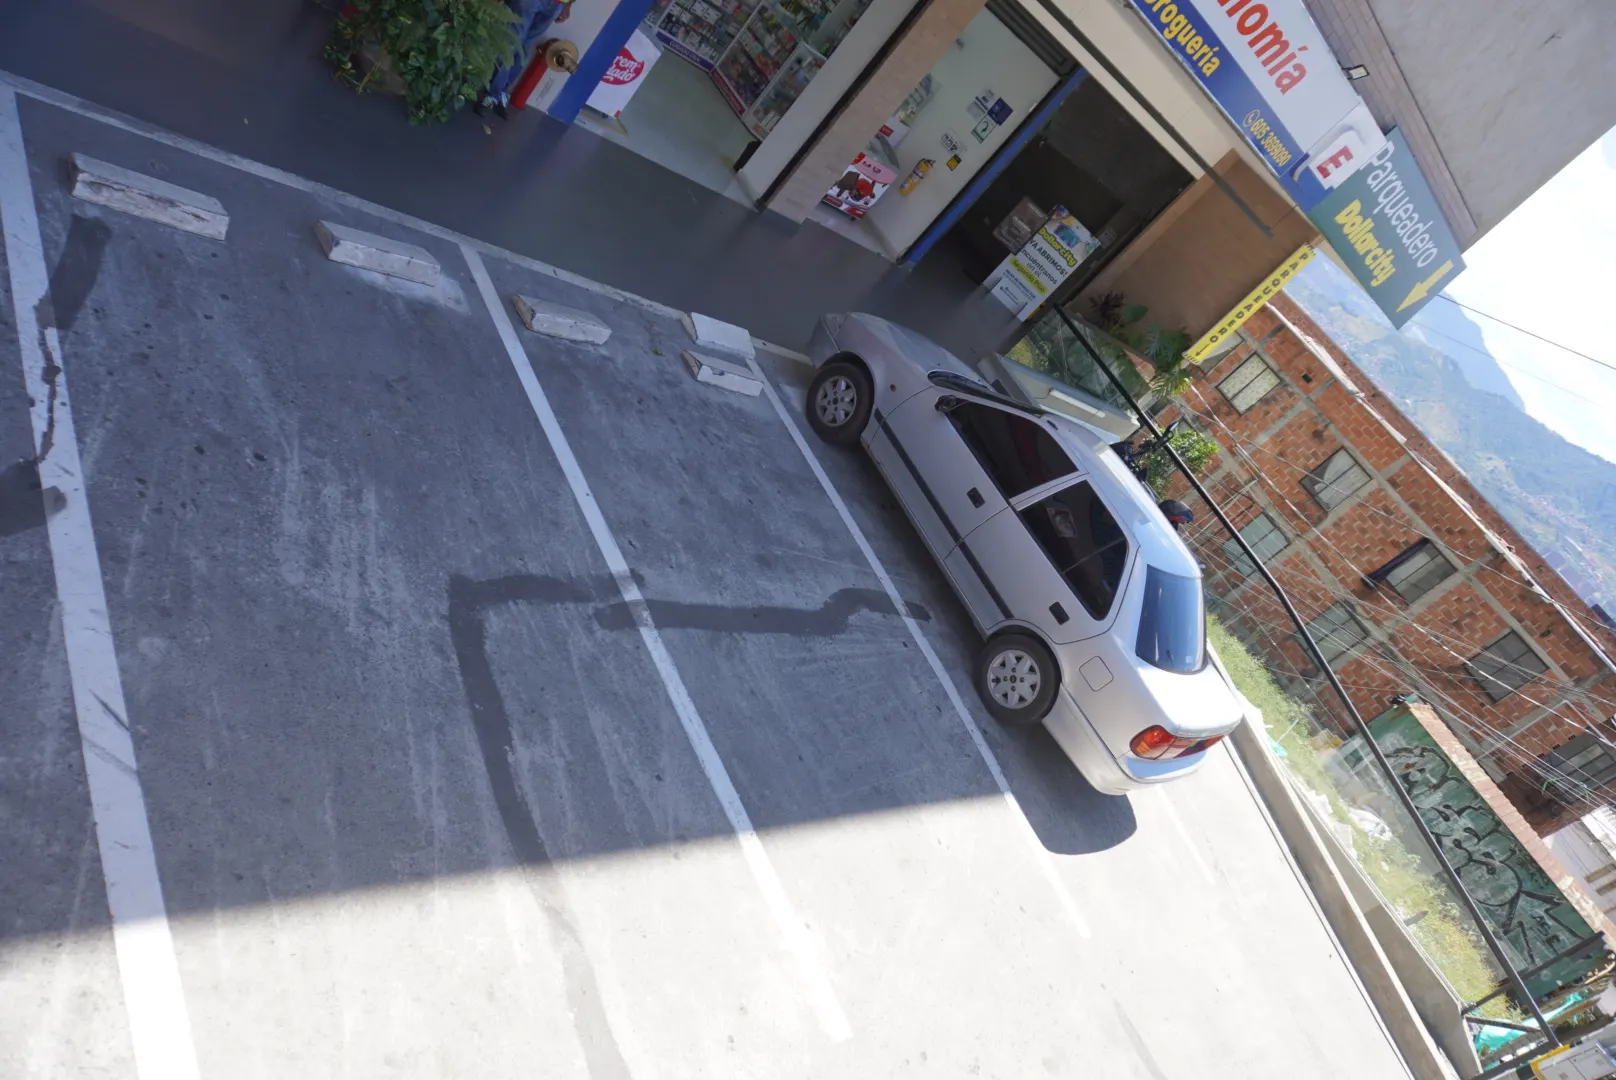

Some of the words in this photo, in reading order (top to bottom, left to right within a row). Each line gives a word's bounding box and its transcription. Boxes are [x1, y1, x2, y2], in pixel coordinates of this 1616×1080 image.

[1143, 0, 1220, 78] roguería
[606, 65, 636, 82] lado
[613, 54, 637, 72] rem
[1250, 118, 1270, 139] 605
[1316, 145, 1354, 179] E
[1359, 140, 1438, 268] Parqueadero
[1039, 226, 1078, 268] Dollarcity
[1335, 199, 1396, 287] Dollarcity
[1021, 249, 1058, 285] ncuéntranos
[1209, 252, 1309, 343] PARQUEADERO
